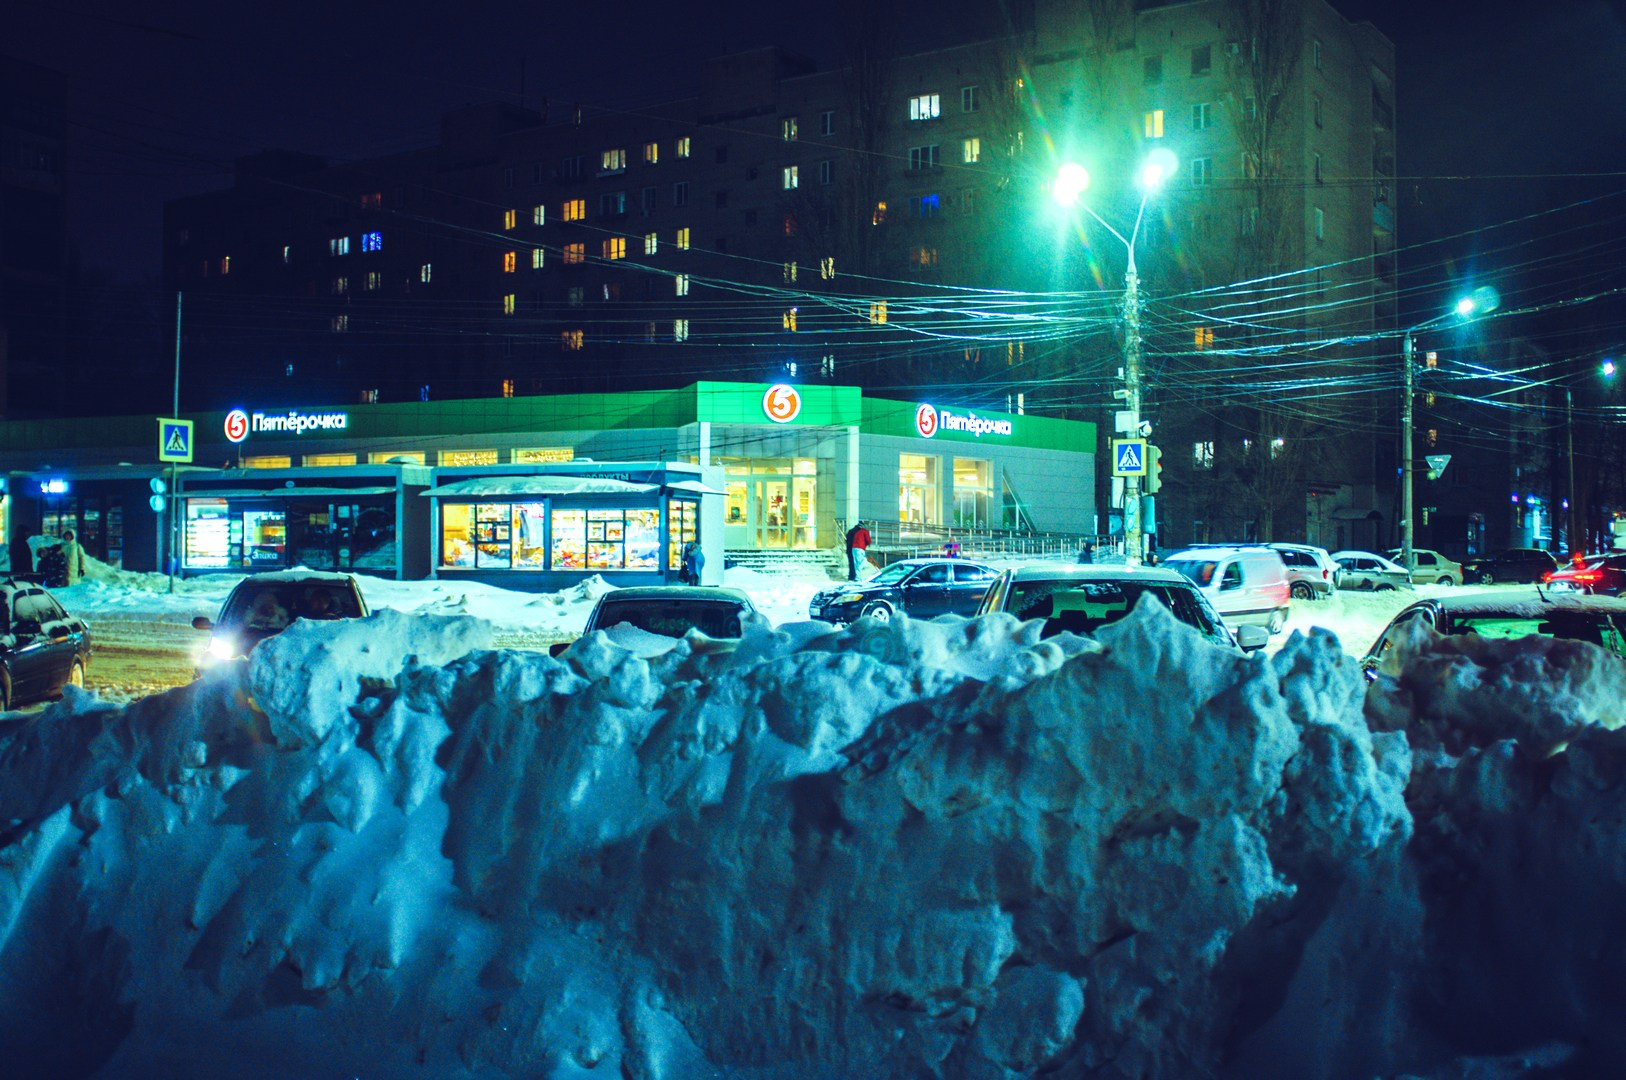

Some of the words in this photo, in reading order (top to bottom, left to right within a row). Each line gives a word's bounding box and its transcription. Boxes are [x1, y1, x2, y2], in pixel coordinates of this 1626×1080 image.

[767, 387, 797, 420] 5
[228, 413, 247, 439] 5
[252, 411, 347, 435] Пятёрочка
[919, 407, 936, 435] 5
[940, 410, 1012, 437] Пятёрочка
